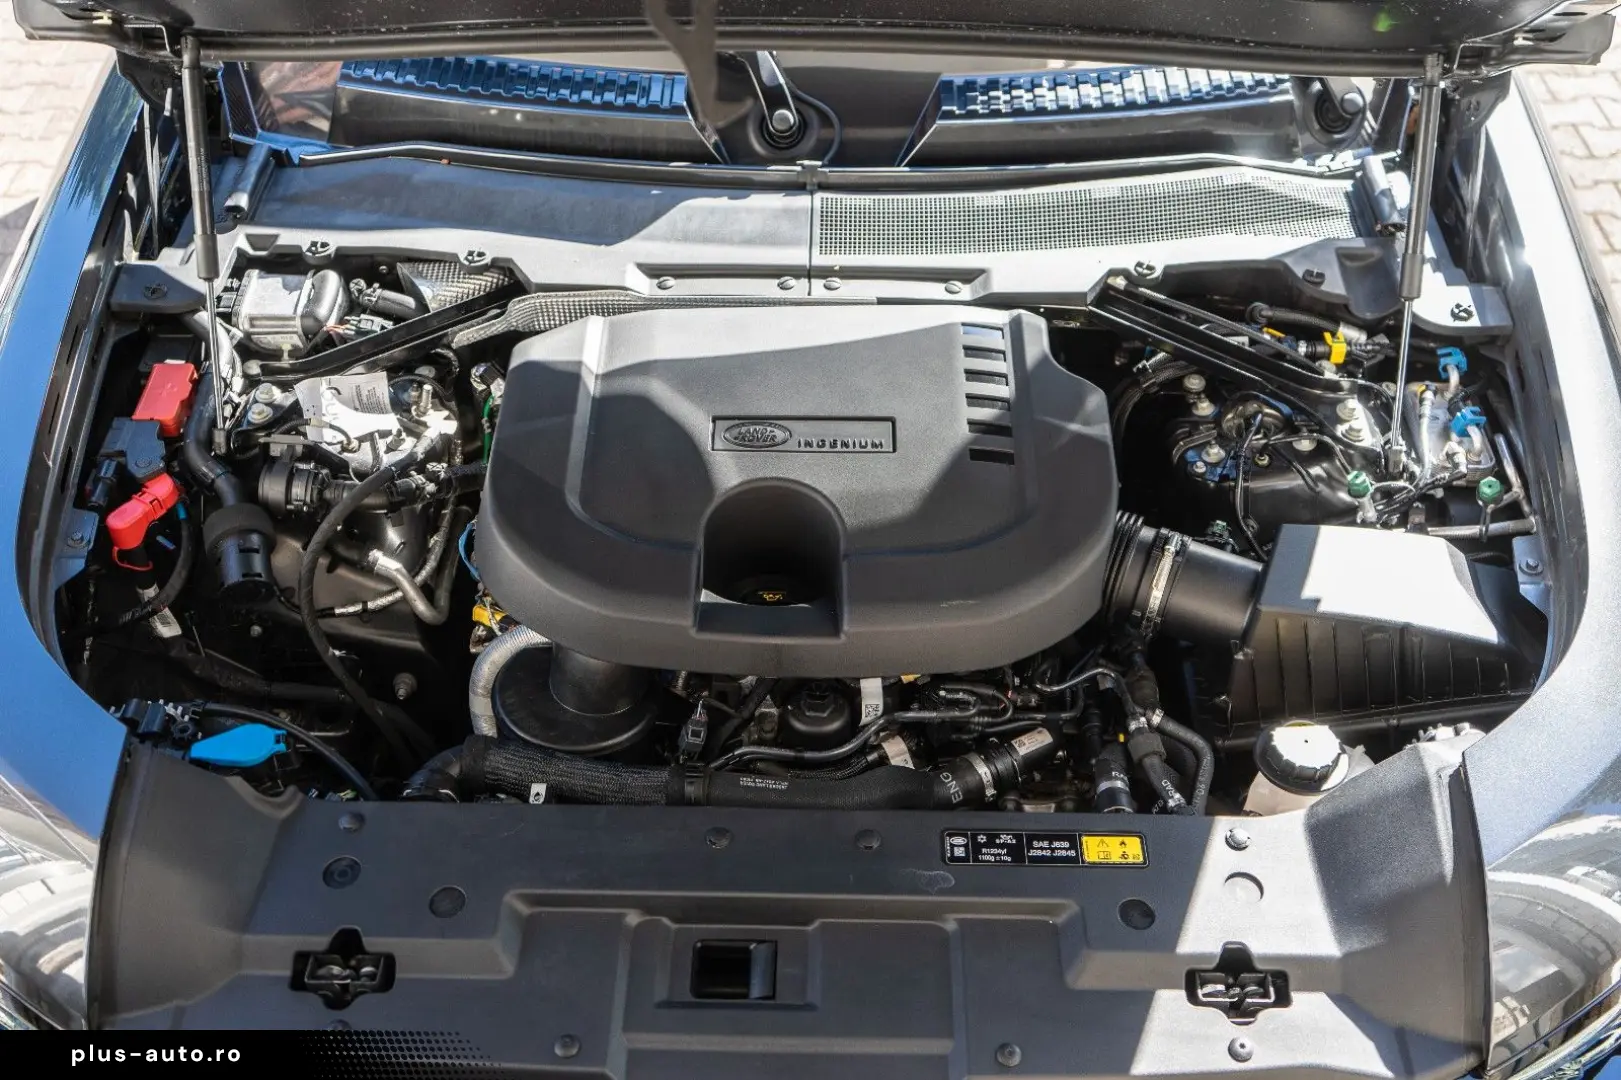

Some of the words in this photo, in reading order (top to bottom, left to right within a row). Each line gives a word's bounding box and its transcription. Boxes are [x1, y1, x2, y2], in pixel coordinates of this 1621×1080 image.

[738, 427, 769, 435] LAND
[738, 435, 778, 443] ROVER
[797, 439, 884, 450] INGENIUM
[940, 772, 963, 804] ENG
[1052, 849, 1076, 857] J2845
